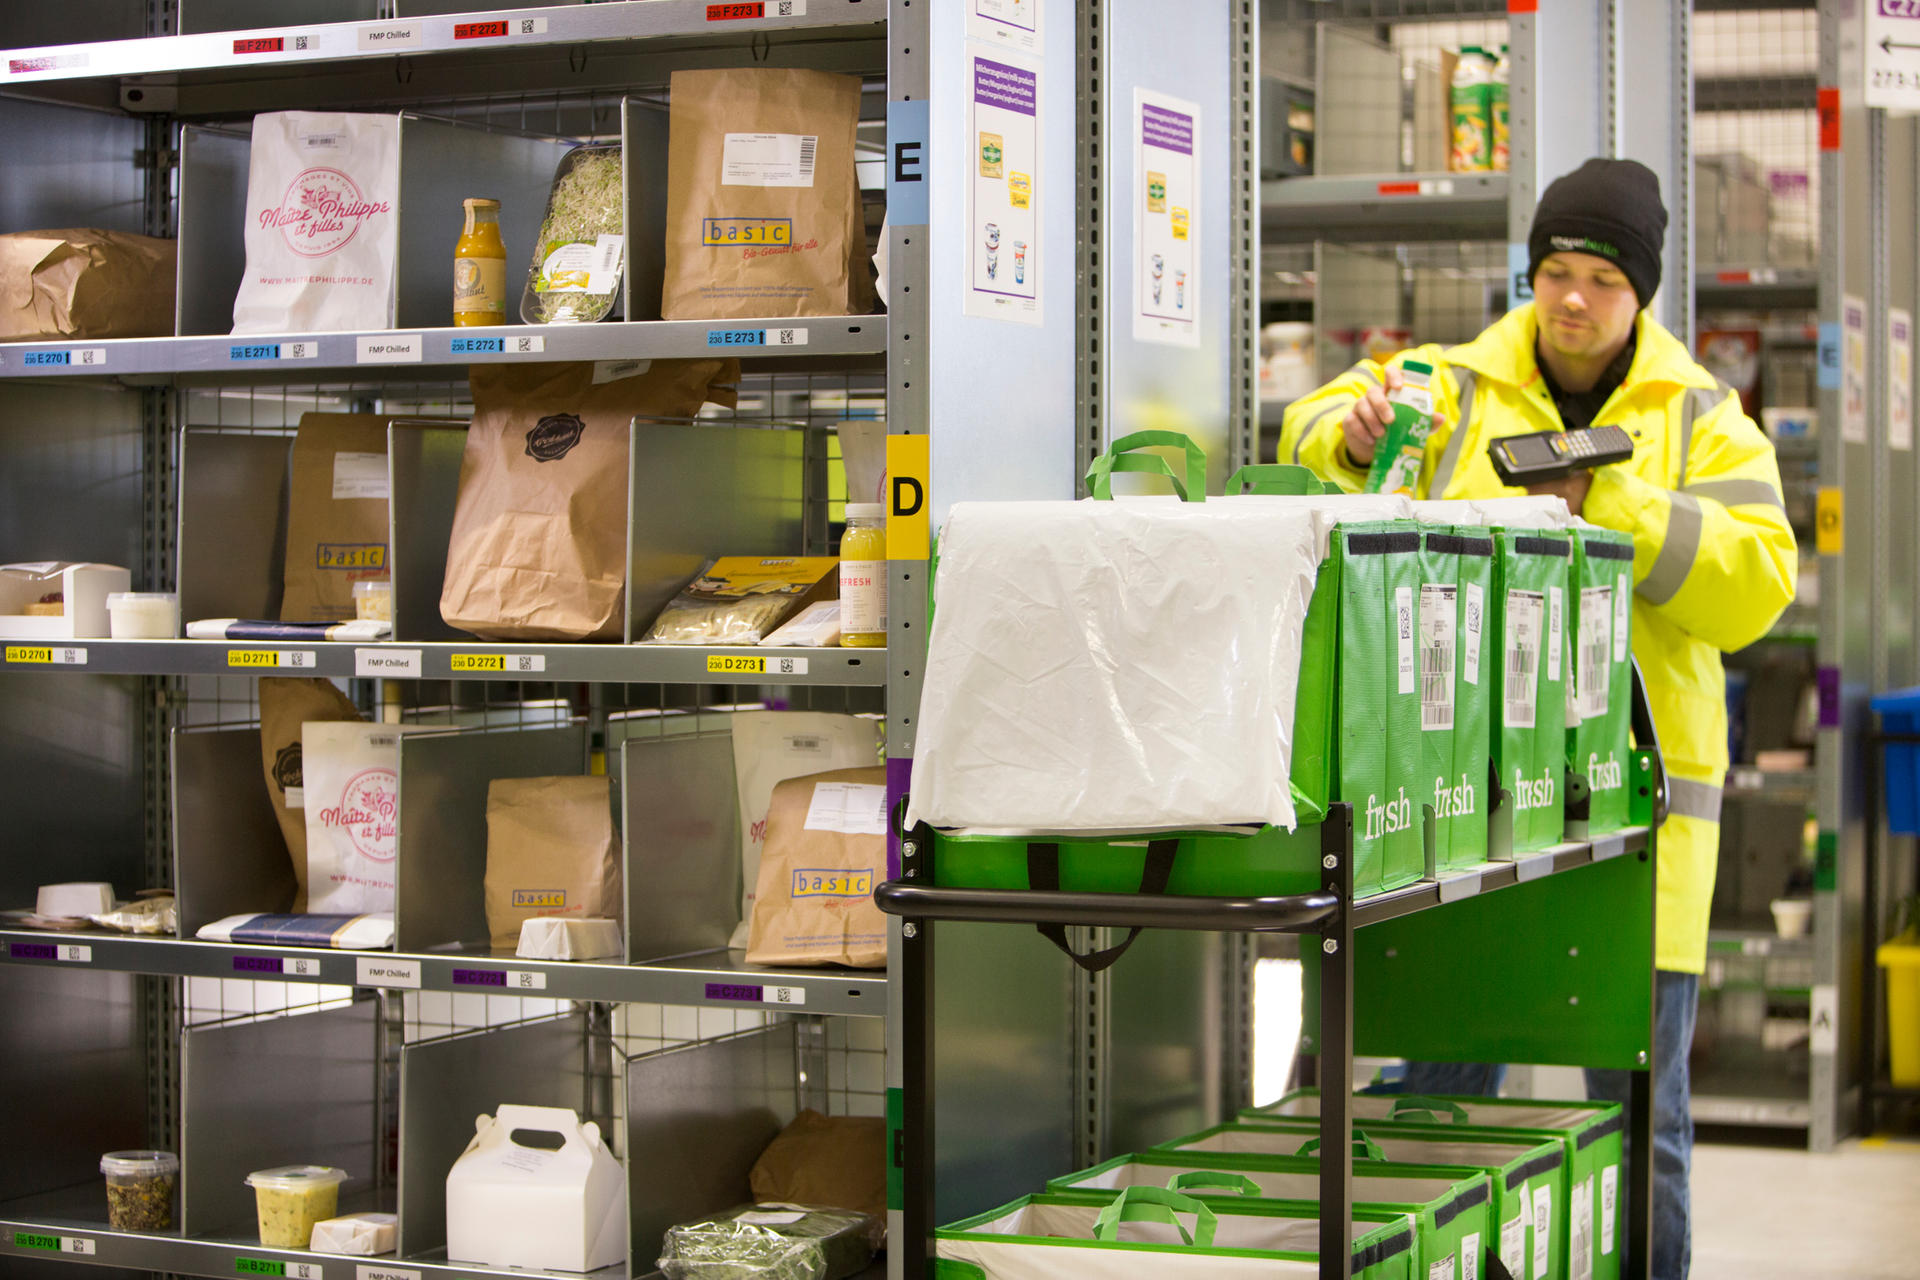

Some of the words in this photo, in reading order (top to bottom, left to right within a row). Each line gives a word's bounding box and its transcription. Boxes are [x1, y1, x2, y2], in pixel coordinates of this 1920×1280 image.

[724, 7, 730, 16] F
[733, 6, 752, 16] 273
[470, 25, 477, 35] F
[479, 24, 496, 34] 272
[386, 30, 411, 40] Chilled
[248, 41, 253, 50] F
[255, 40, 272, 50] 271
[895, 142, 922, 182] E
[320, 200, 390, 220] Philippe
[308, 218, 344, 238] filles
[710, 219, 784, 241] basic
[725, 334, 732, 343] E
[734, 332, 754, 343] 273
[386, 345, 410, 353] Chilled
[467, 340, 474, 350] E
[476, 340, 495, 350] 272
[37, 354, 43, 363] E
[45, 353, 62, 363] 270
[245, 349, 251, 358] E
[253, 348, 270, 357] 271
[893, 476, 923, 516] D
[323, 546, 378, 564] basic
[20, 650, 26, 659] D
[28, 650, 44, 659] 270
[243, 654, 250, 663] D
[252, 654, 269, 663] 271
[385, 659, 409, 668] Chilled
[468, 657, 475, 667] D
[478, 658, 496, 667] 272
[725, 659, 733, 669] D
[736, 660, 755, 669] 273
[320, 807, 375, 827] Maître
[362, 826, 372, 838] et
[799, 872, 866, 892] basic
[518, 891, 560, 904] basic
[369, 968, 385, 977] FMP
[386, 969, 410, 978] Chilled
[722, 986, 730, 996] C
[28, 1236, 35, 1245] B
[37, 1237, 53, 1248] 270
[251, 1261, 257, 1270] B
[259, 1262, 276, 1272] 271
